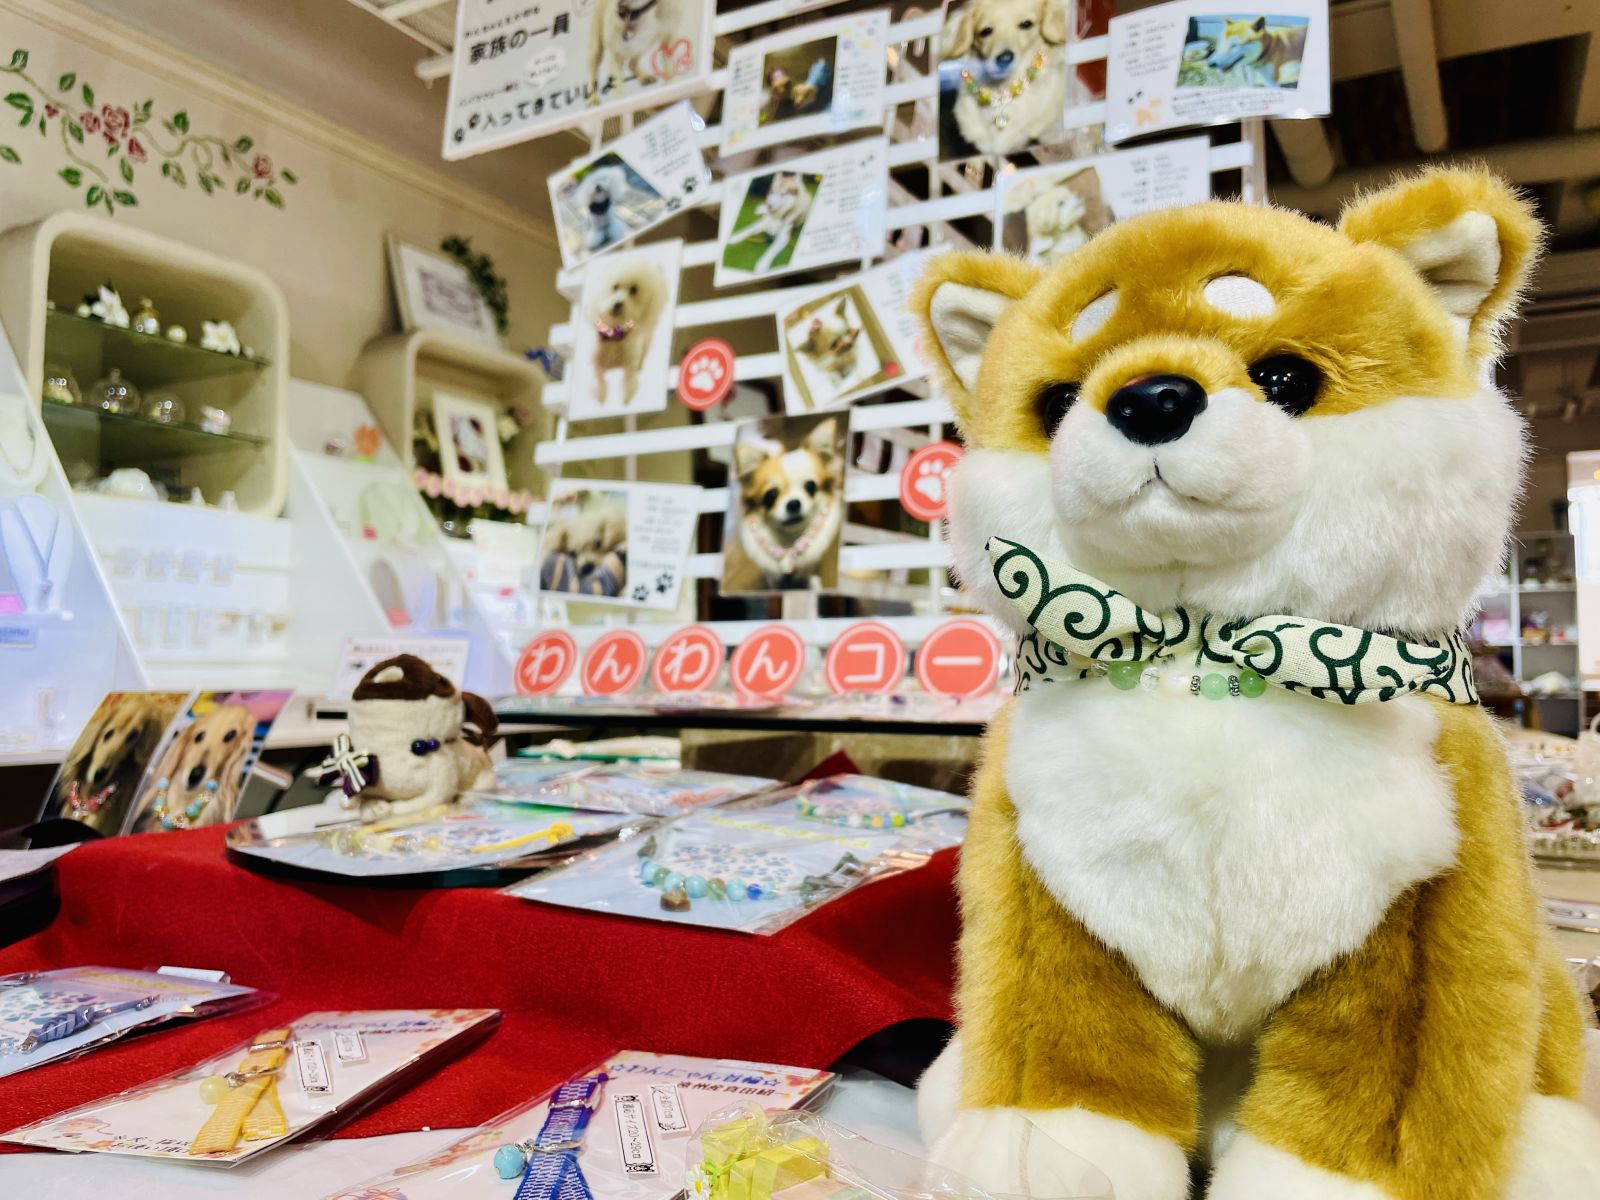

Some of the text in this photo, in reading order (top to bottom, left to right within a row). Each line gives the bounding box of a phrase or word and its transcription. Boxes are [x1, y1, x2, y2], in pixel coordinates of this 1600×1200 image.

[469, 11, 570, 64] 家族の一員
